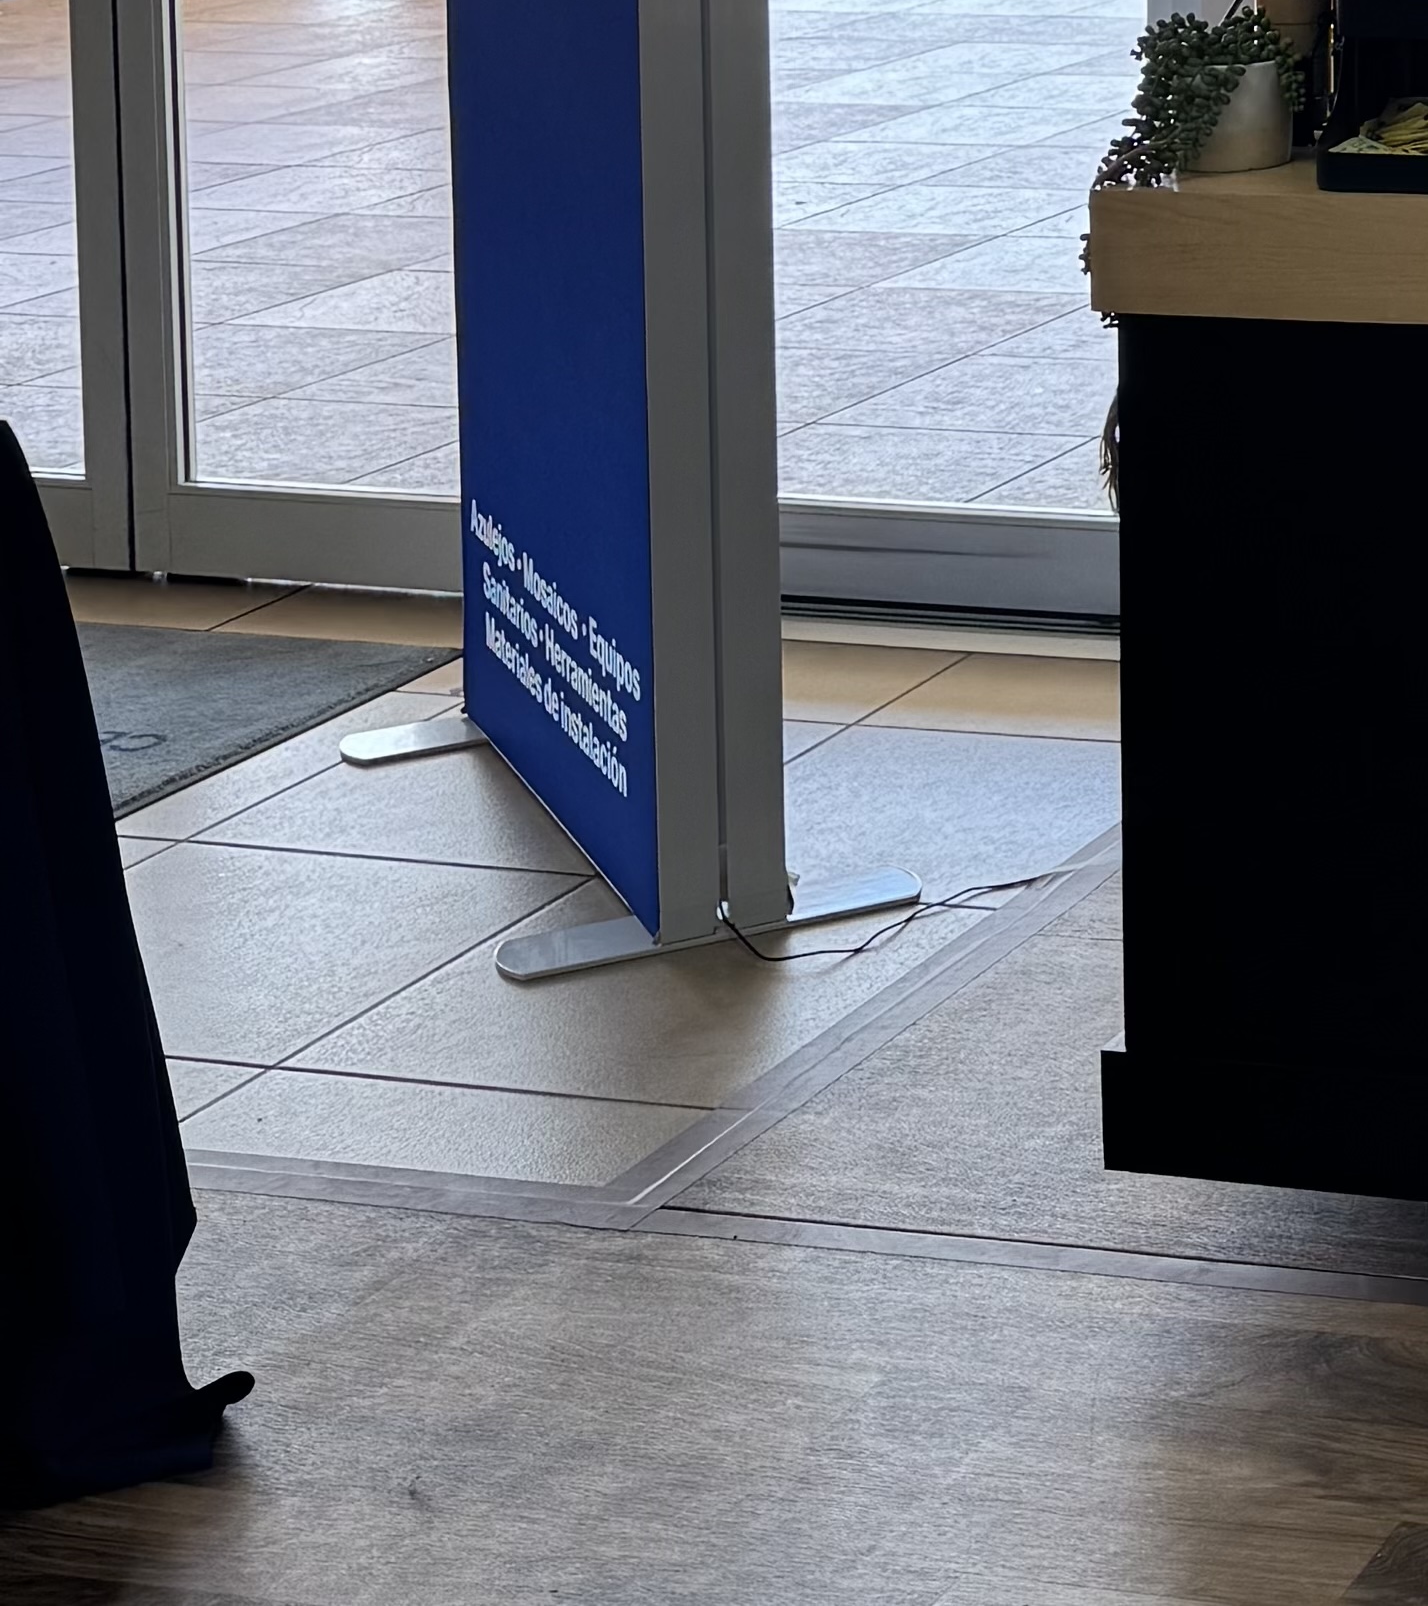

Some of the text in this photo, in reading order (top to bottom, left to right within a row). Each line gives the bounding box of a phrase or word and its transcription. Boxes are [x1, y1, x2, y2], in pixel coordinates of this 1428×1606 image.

[470, 499, 641, 702] Azulejos Mosaicos Equipos
[482, 561, 628, 743] Sanitarios Herramientas
[485, 611, 628, 798] Materiales de instalación
